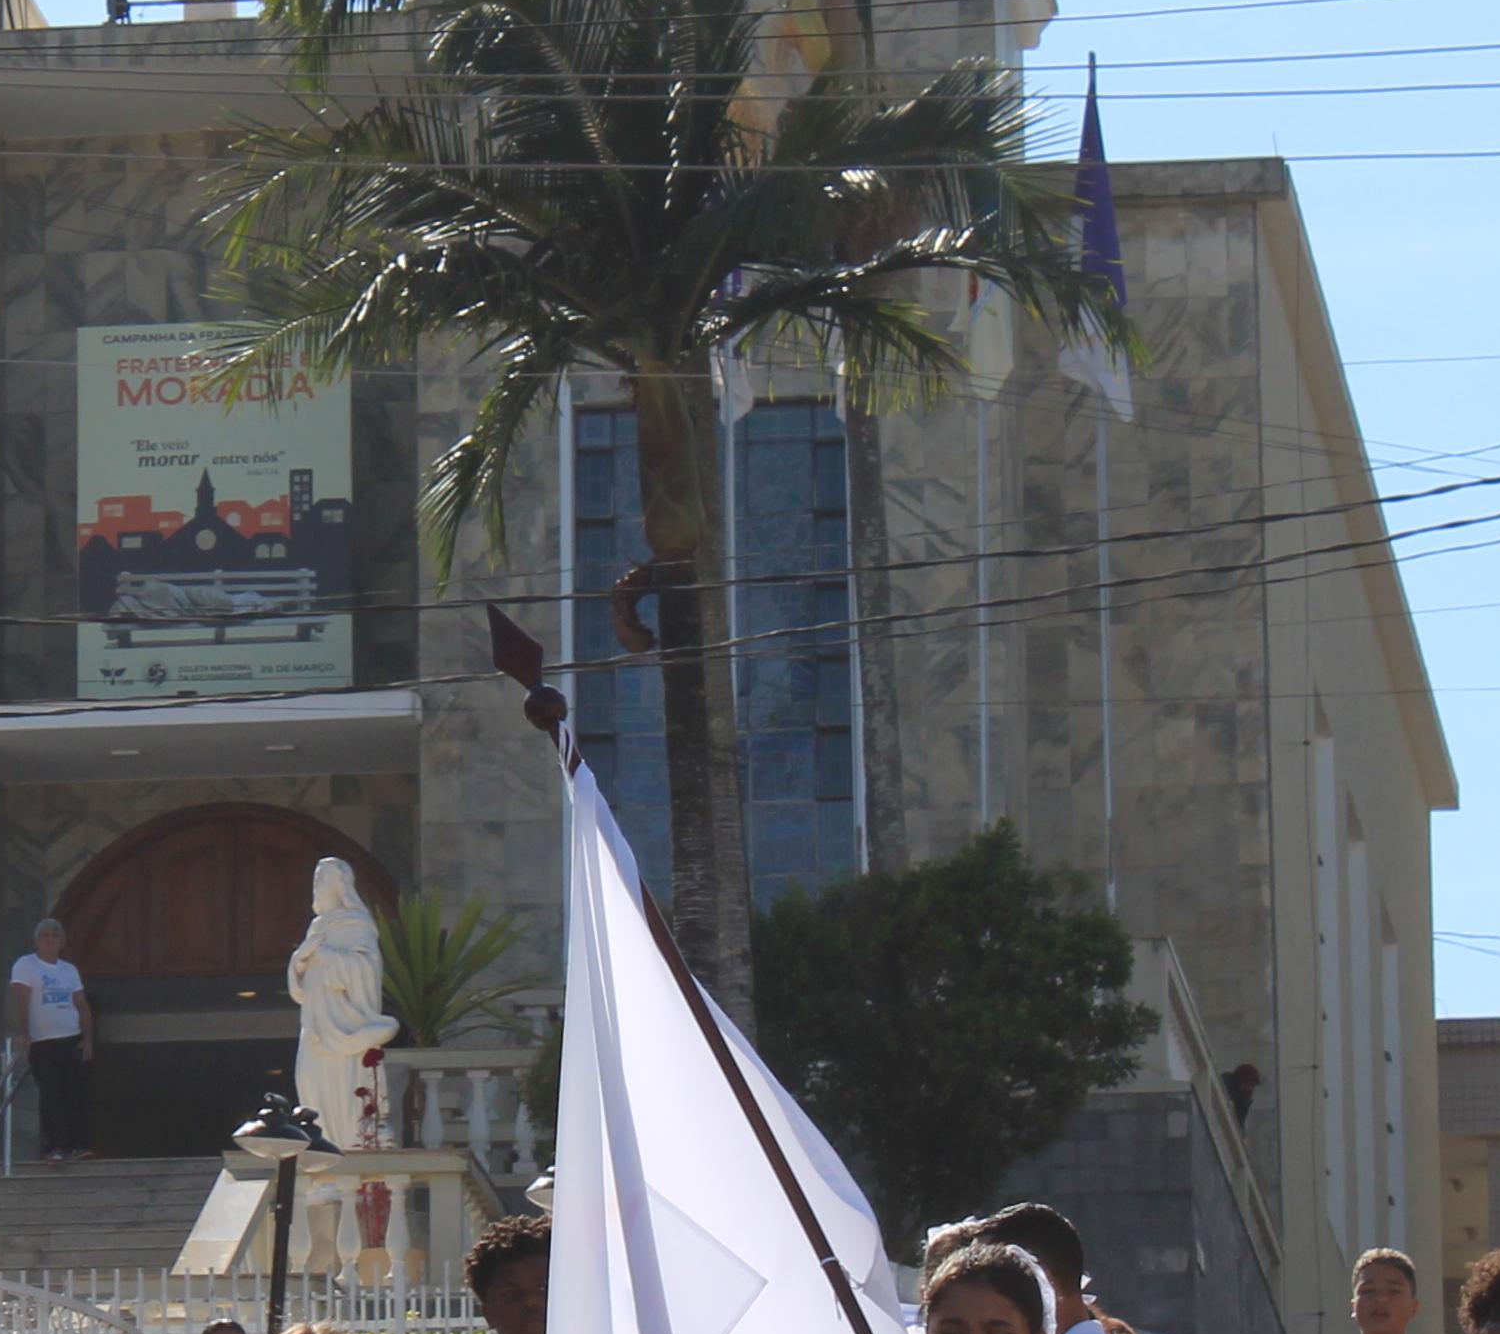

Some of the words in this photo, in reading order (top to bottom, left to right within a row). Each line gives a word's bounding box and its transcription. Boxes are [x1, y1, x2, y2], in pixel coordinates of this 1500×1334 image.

[103, 332, 176, 344] CAMPANHA
[179, 331, 196, 342] DA
[161, 439, 189, 451] veio
[138, 453, 200, 468] morar
[212, 453, 249, 466] entre
